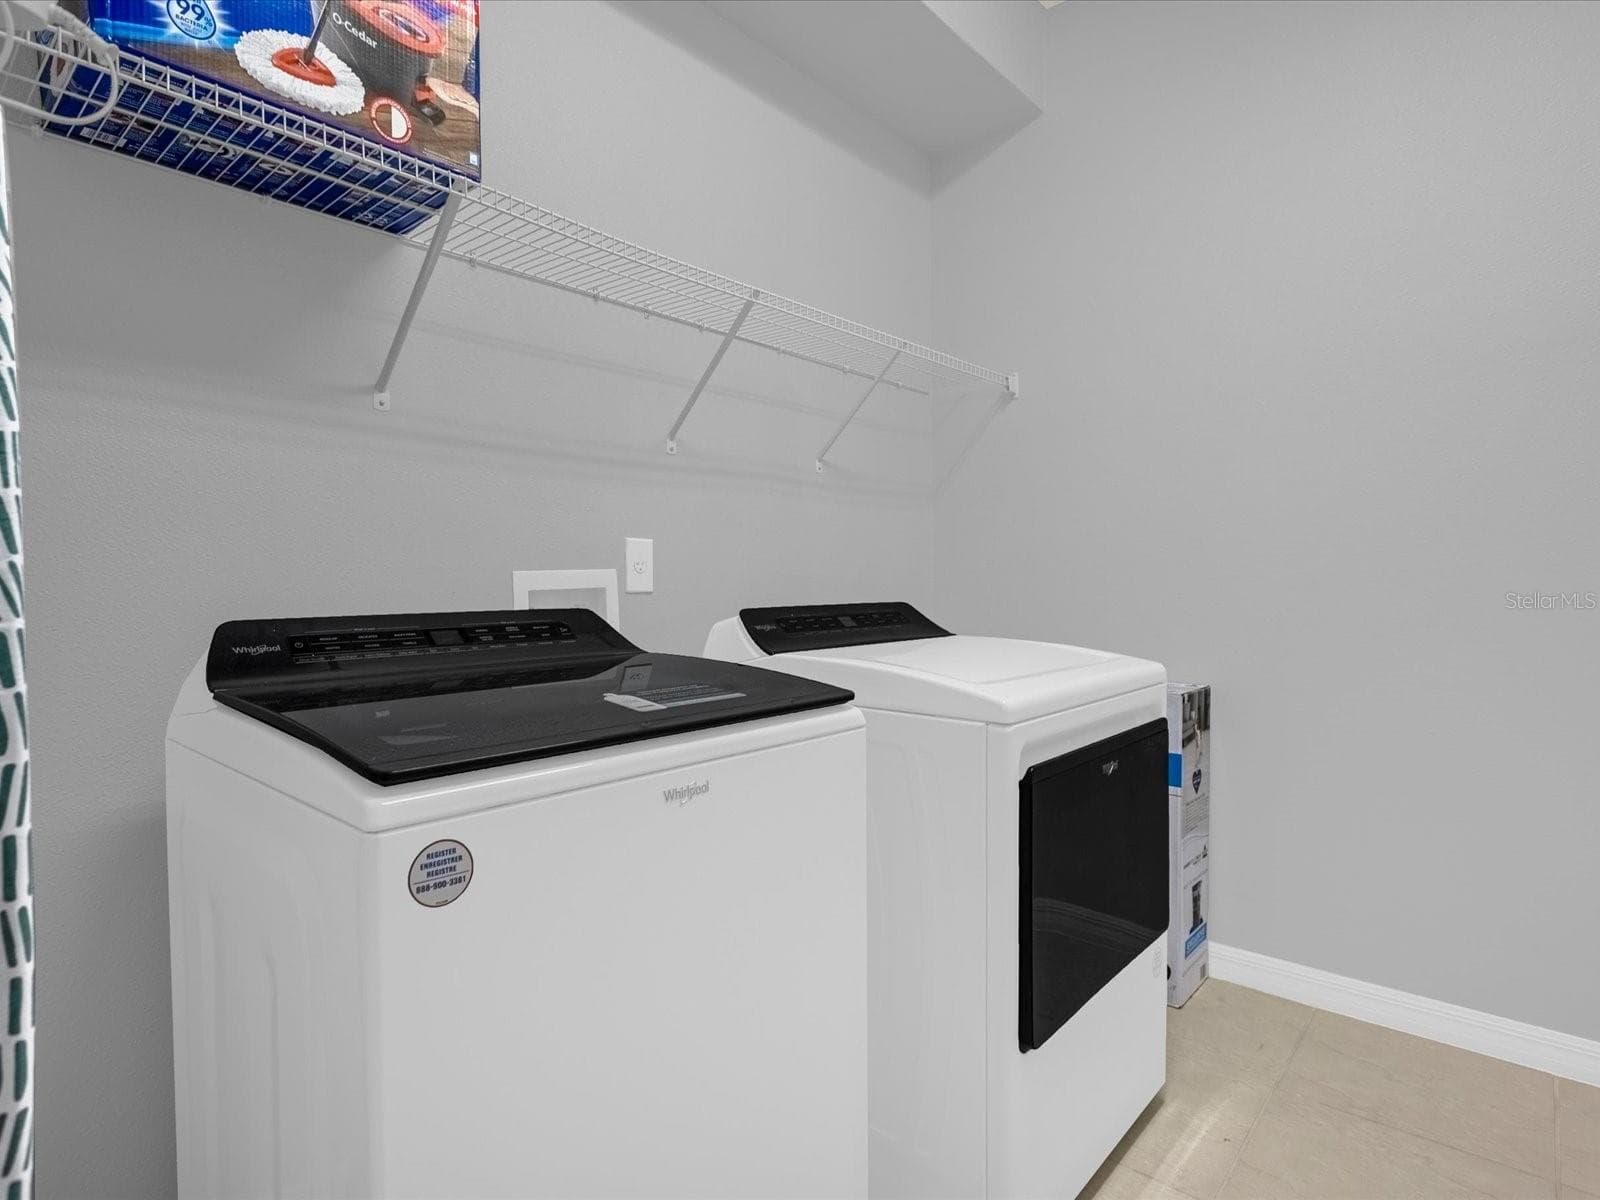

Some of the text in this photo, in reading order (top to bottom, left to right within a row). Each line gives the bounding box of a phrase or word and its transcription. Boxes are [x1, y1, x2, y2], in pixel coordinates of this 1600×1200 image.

[175, 14, 208, 31] BACTERIA
[333, 12, 378, 49] O-Cedar
[231, 643, 282, 656] Whirlpool
[663, 779, 710, 802] Whirlpool
[426, 847, 457, 860] REGISTER
[420, 854, 463, 871] ENREGISTRER
[426, 865, 457, 878] REGISTRE
